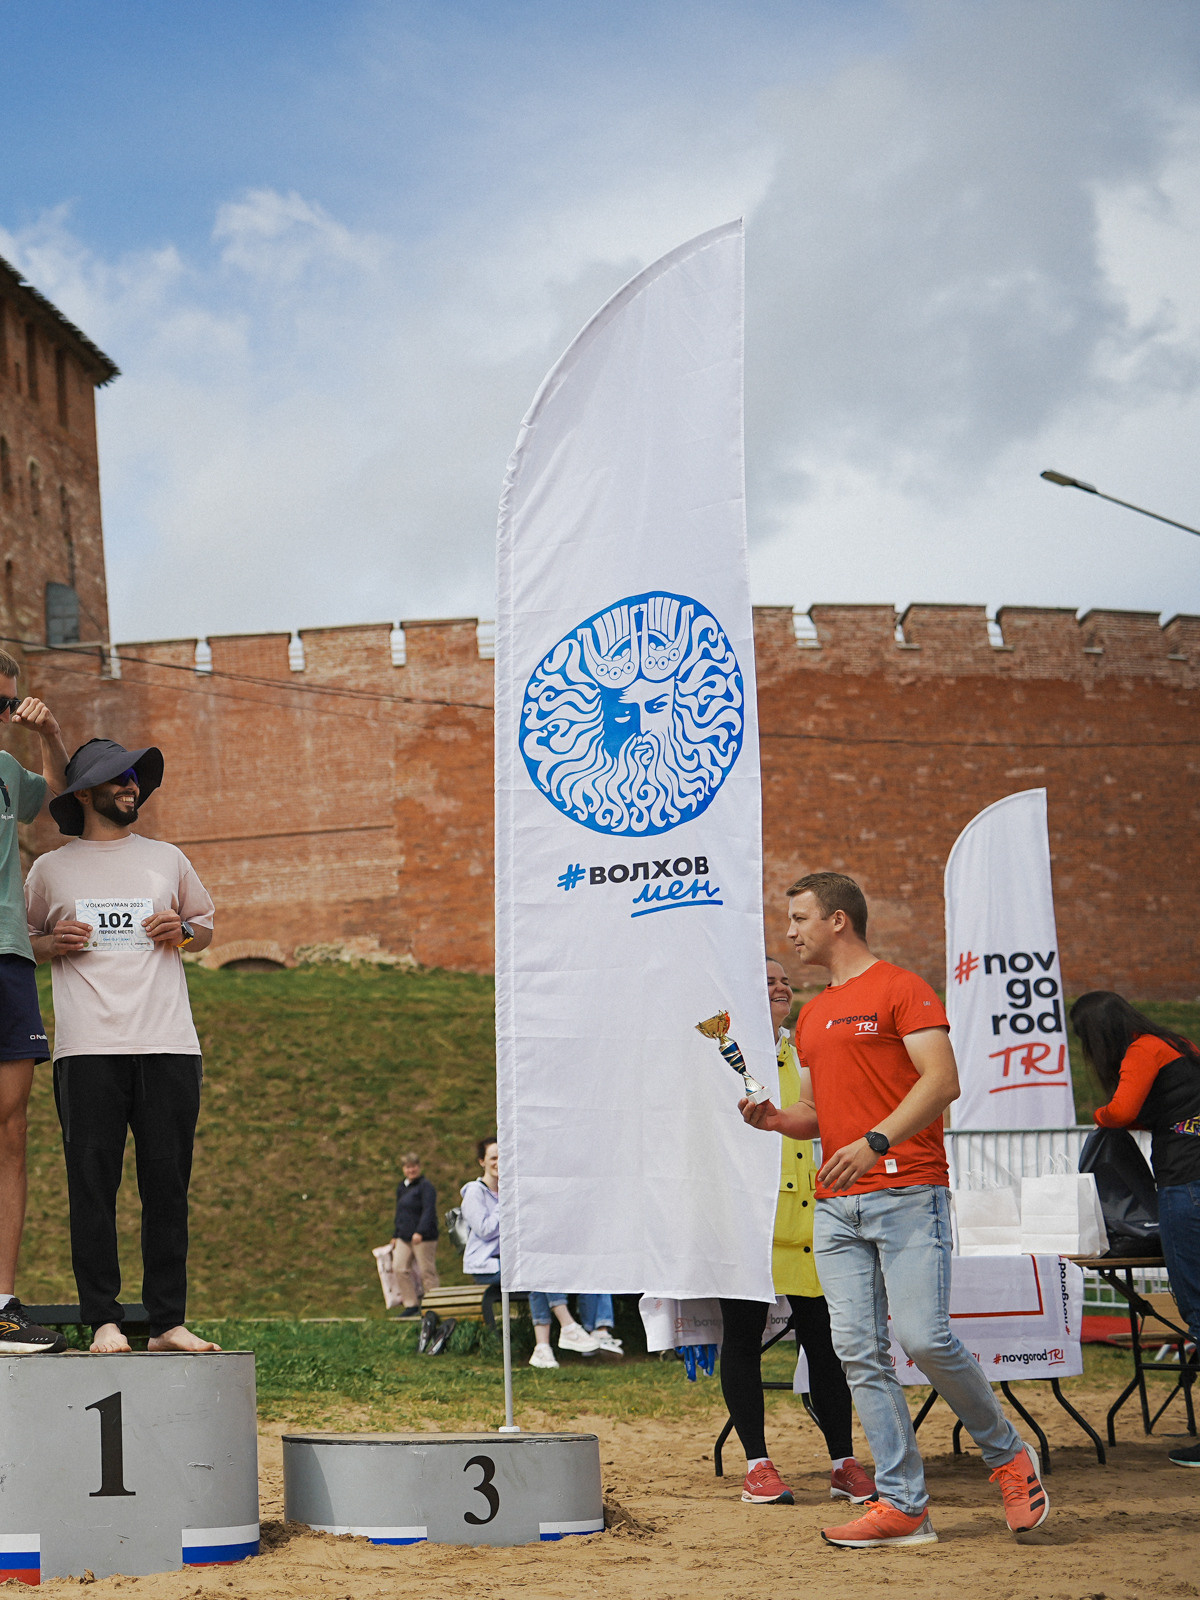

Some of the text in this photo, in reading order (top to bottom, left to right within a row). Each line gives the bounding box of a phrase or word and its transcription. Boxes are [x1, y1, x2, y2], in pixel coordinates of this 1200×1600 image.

[98, 912, 133, 928] 102
[955, 951, 1056, 985] #nov
[1006, 977, 1059, 1010] go
[826, 1012, 878, 1029] #novgorod
[855, 1021, 878, 1032] TRI
[991, 999, 1063, 1036] rod
[989, 1042, 1066, 1078] TRI
[85, 1391, 136, 1497] 1
[463, 1455, 500, 1525] 3
